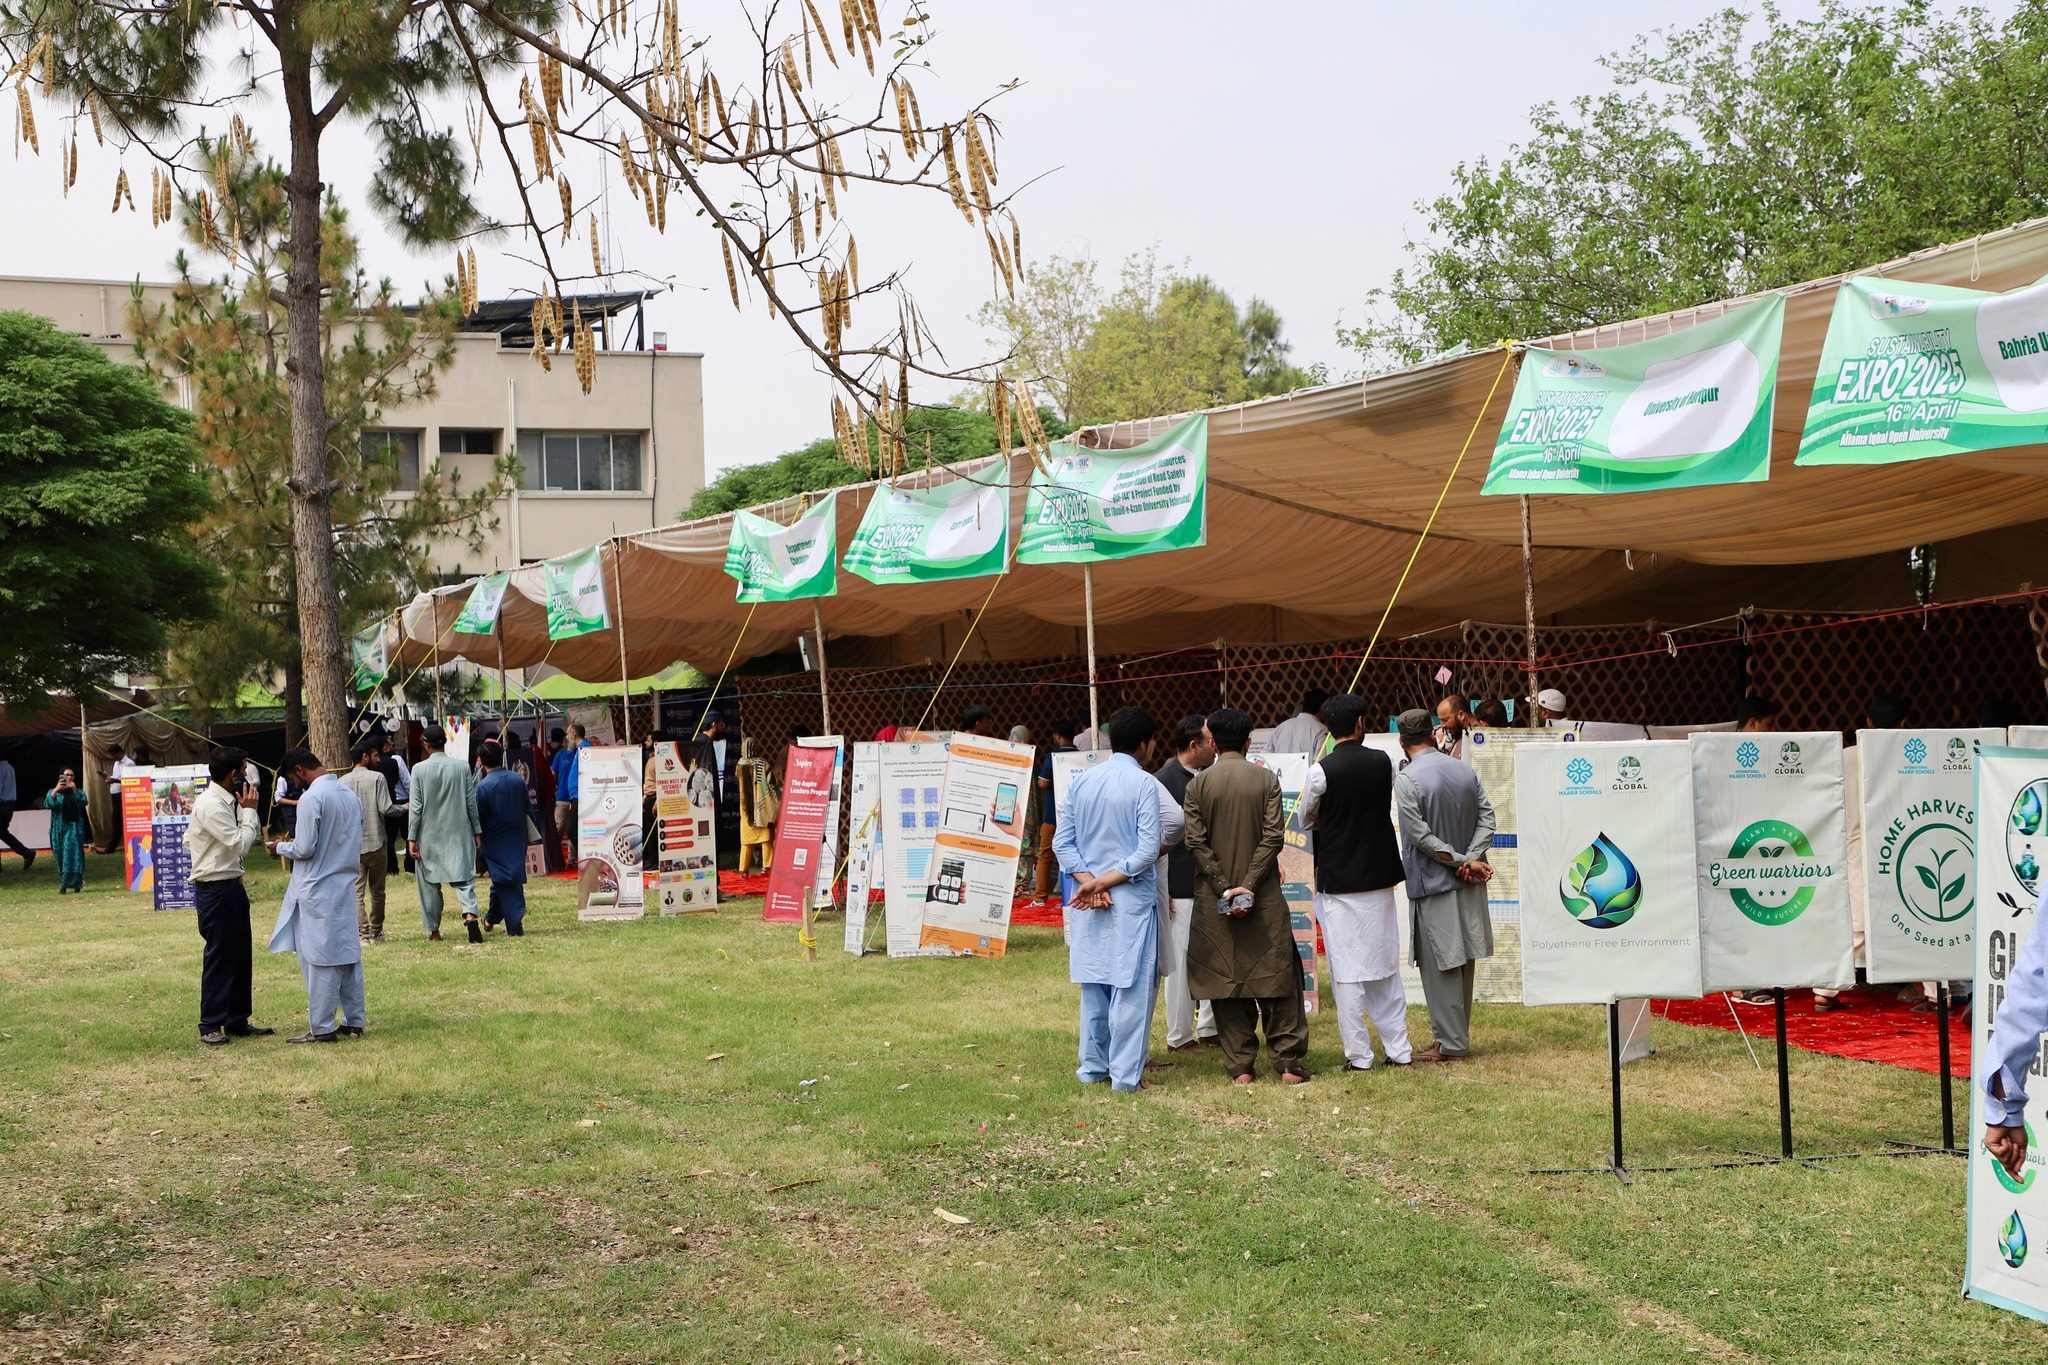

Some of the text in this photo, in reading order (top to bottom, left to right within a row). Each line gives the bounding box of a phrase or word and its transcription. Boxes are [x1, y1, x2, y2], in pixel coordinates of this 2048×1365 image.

[1867, 329, 1952, 356] SUSTAINABILITY
[1998, 335, 2039, 360] Bahria
[1833, 352, 1965, 402] EXPO 2025
[1536, 390, 1611, 407] SUSTAINABILITY
[1912, 400, 1960, 425] April
[1508, 406, 1603, 445] EXPO 2025
[1840, 426, 1950, 446] Allama Iqbal Open University
[1557, 444, 1583, 465] April
[1167, 469, 1186, 480] Safety
[1135, 487, 1153, 499] Project
[1153, 485, 1173, 496] Funded
[794, 759, 812, 768] Aspire
[801, 780, 817, 788] Aspire
[1741, 827, 1765, 847] PLANT
[1878, 799, 1974, 875] HOME HARVES
[1709, 862, 1835, 887] Green warriors
[1741, 899, 1762, 917] BUILD
[1774, 900, 1802, 919] FUTURE
[1891, 913, 1971, 947] One Seed at a
[1532, 937, 1690, 950] Polyethene Free Environment
